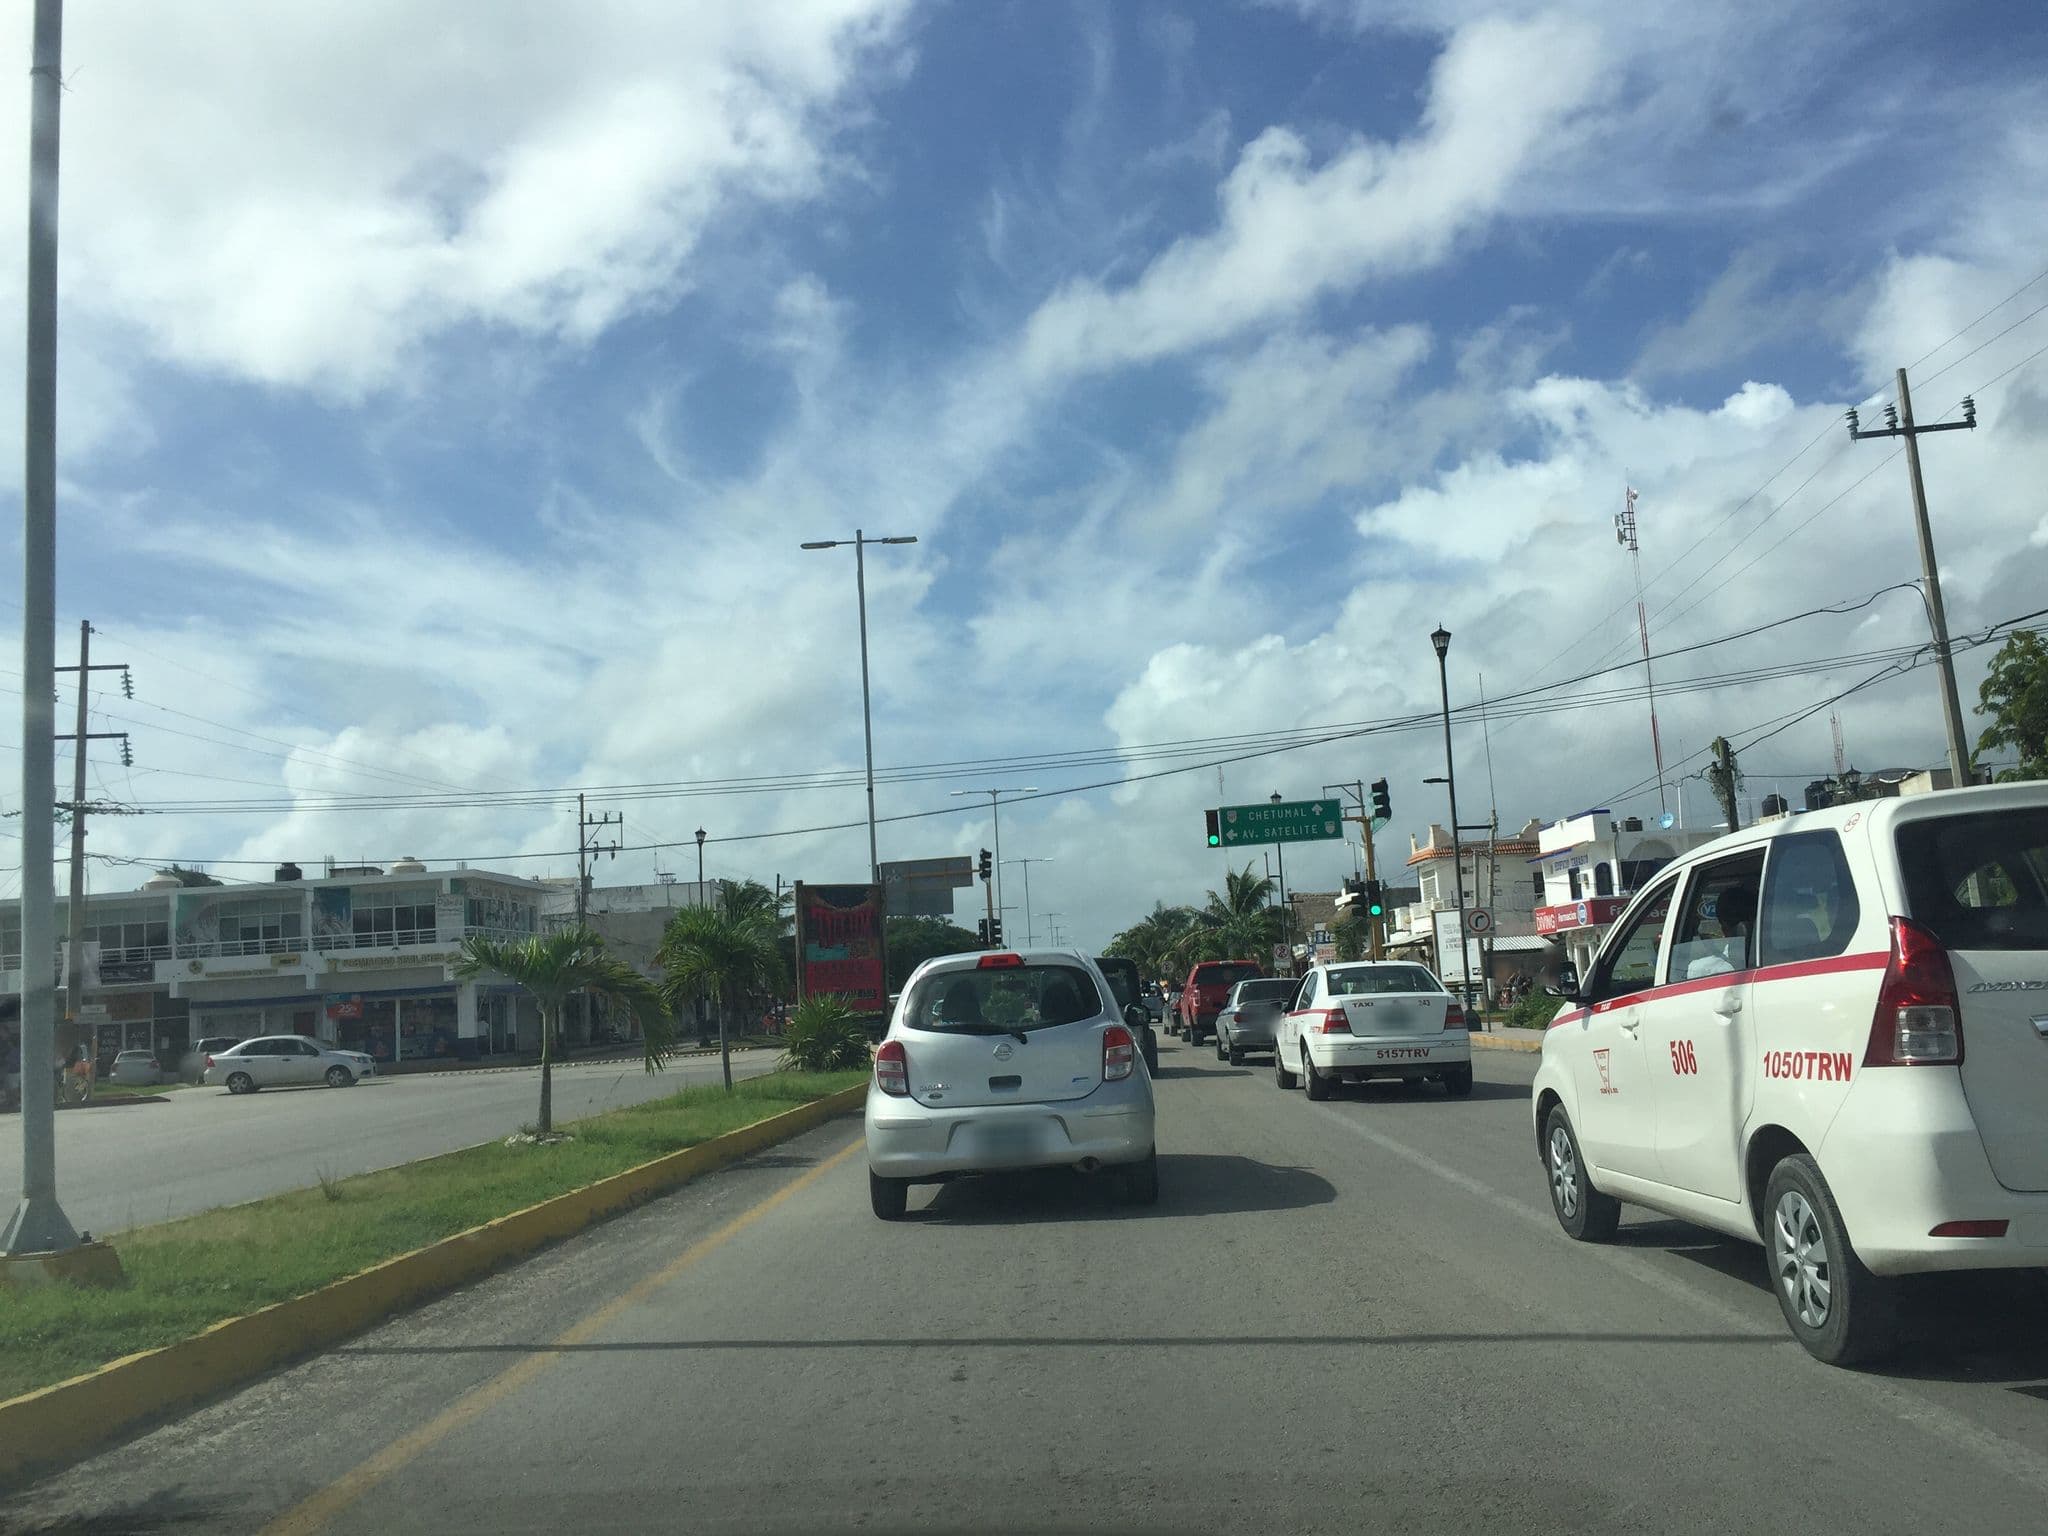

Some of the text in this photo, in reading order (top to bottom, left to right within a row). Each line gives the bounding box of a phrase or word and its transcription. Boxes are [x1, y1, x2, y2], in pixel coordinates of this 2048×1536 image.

[1249, 808, 1307, 821] CHETUMAL
[1243, 824, 1318, 839] AV. SATELITE
[1967, 980, 2048, 993] AVANZ
[1377, 1048, 1430, 1059] 5157TRV
[1670, 1039, 1698, 1075] 506
[1763, 1051, 1852, 1082] 1050TRW
